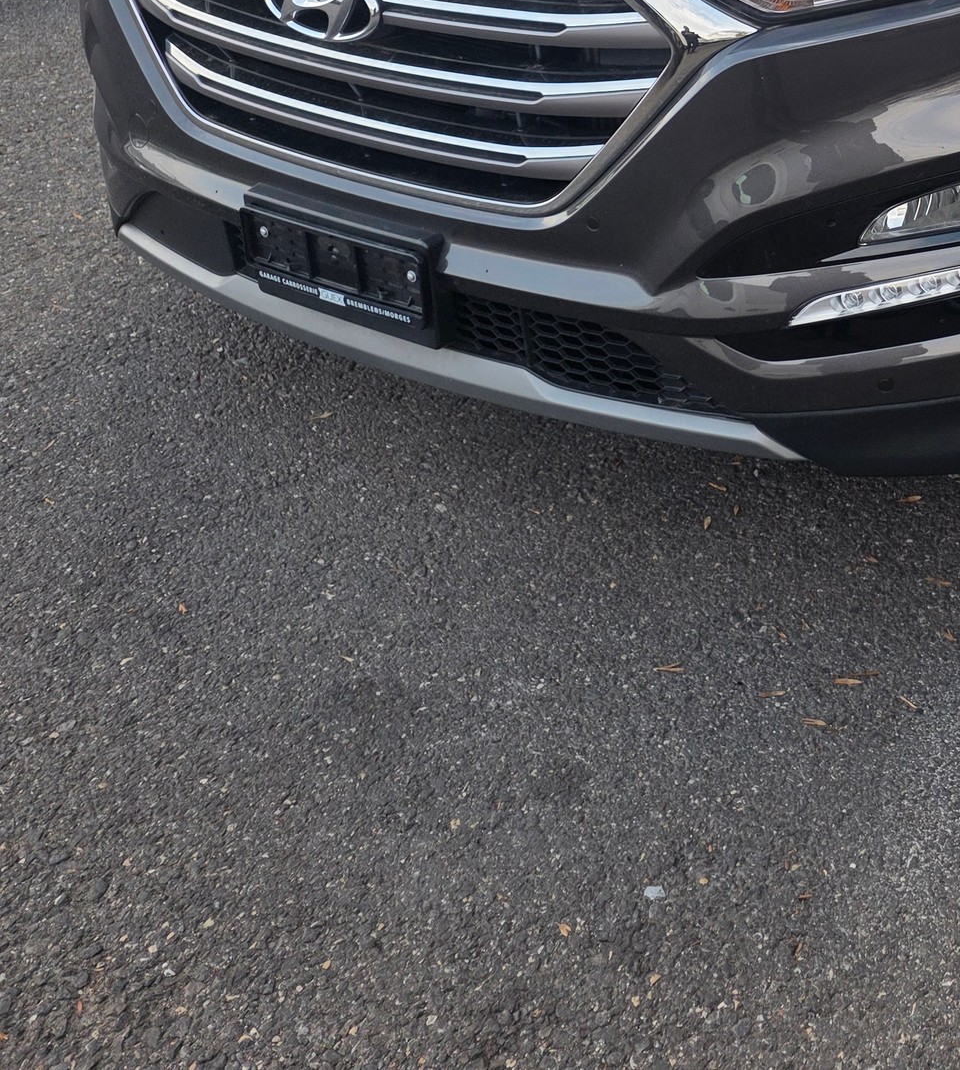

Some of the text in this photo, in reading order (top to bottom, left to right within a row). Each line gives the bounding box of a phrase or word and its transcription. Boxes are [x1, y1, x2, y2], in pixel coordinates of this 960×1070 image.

[259, 270, 281, 283] GARAGE
[282, 277, 318, 295] CARROSSERIE
[321, 290, 344, 304] GUEX
